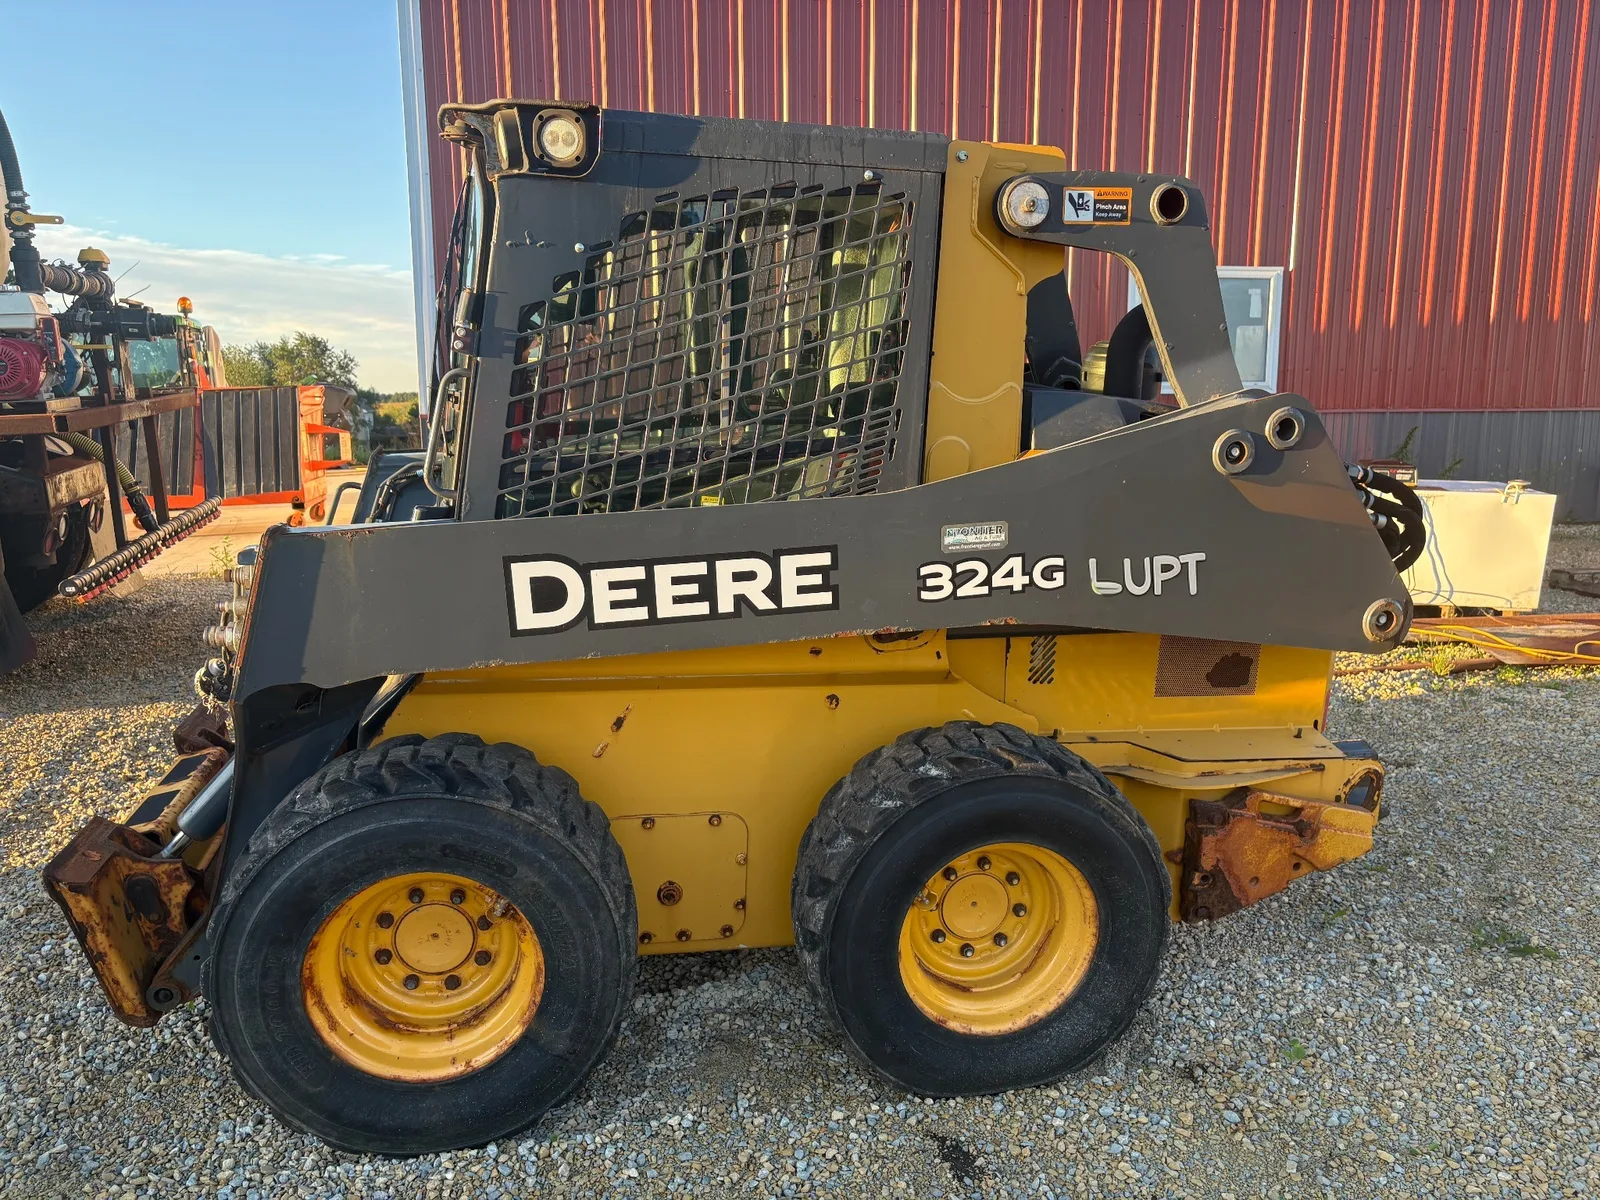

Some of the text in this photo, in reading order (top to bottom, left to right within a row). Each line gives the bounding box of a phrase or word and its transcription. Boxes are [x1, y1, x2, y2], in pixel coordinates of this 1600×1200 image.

[510, 550, 834, 631] DEERE
[919, 552, 1207, 601] 324G LUPT
